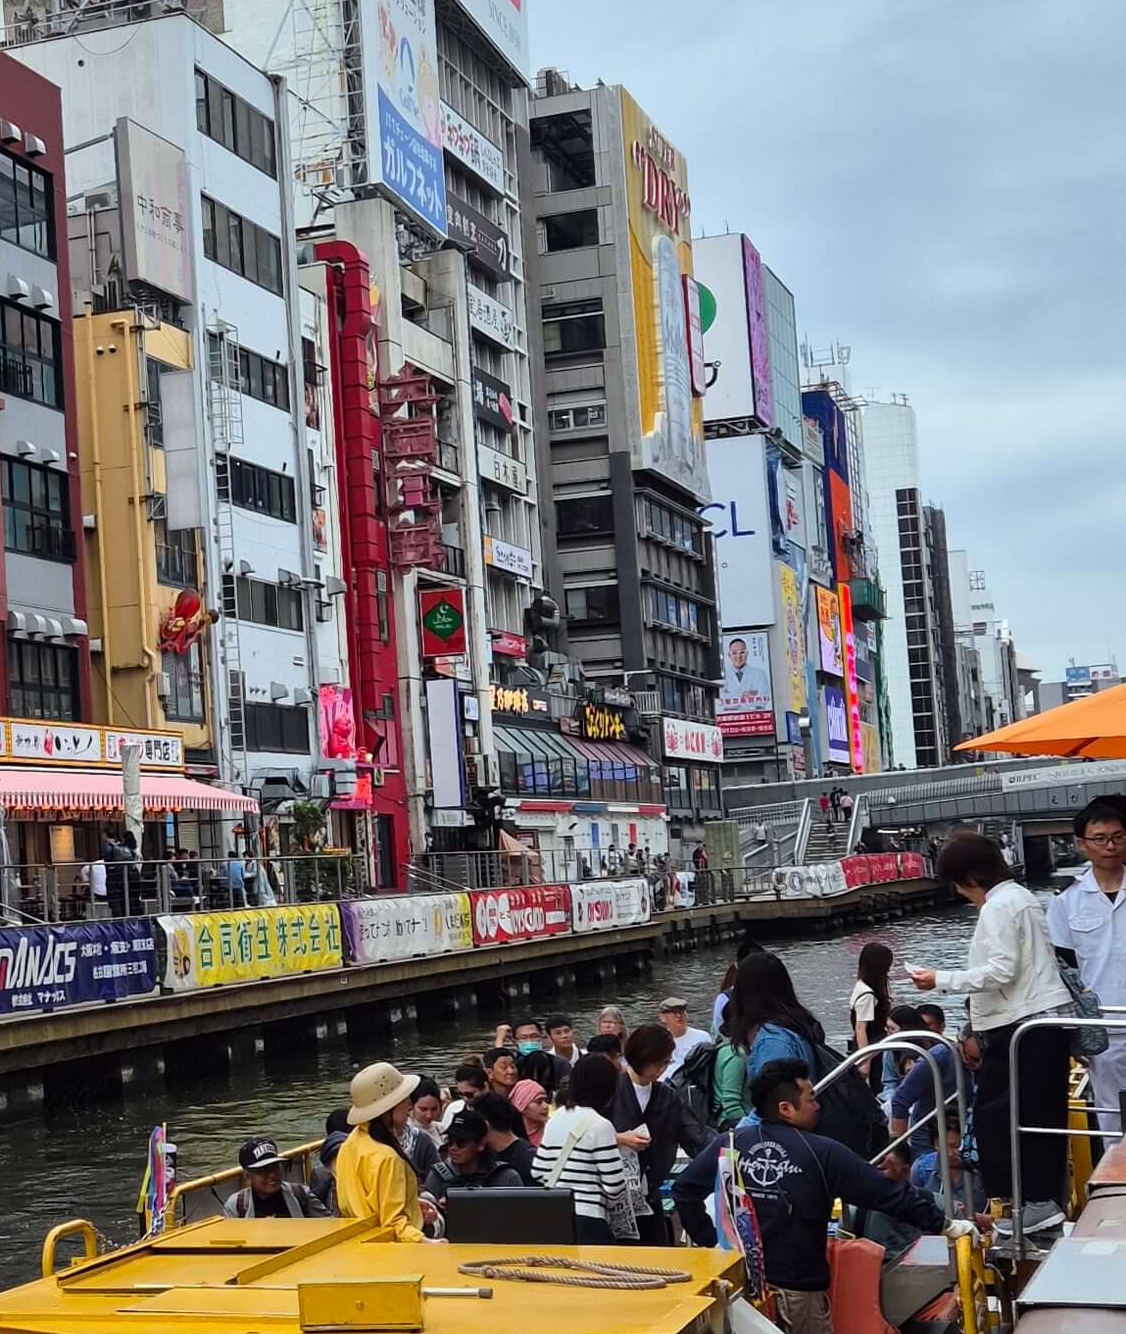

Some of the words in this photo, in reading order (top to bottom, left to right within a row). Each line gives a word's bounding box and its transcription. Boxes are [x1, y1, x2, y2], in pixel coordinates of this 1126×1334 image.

[384, 138, 443, 220] ガルフネット
[197, 911, 341, 970] 合同衛生株式会社
